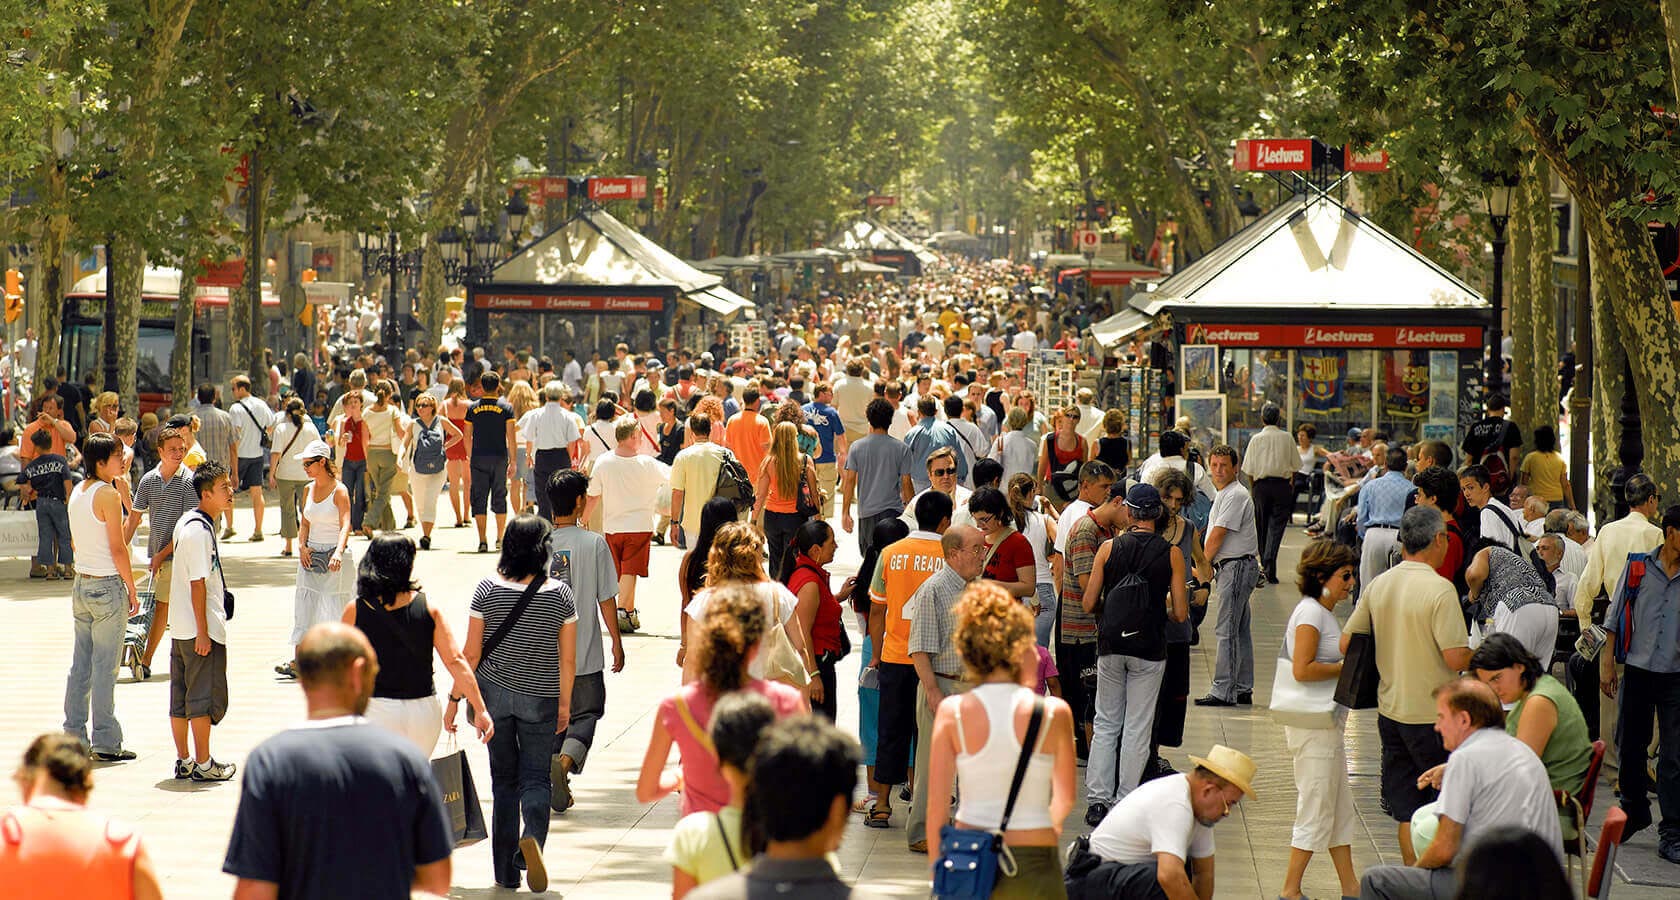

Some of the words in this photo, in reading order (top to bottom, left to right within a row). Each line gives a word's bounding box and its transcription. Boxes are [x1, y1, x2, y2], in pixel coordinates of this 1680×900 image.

[1264, 146, 1304, 163] Lecturas
[1316, 329, 1375, 342] Lecturas
[1407, 330, 1466, 342] Lecturas
[890, 554, 909, 570] GET
